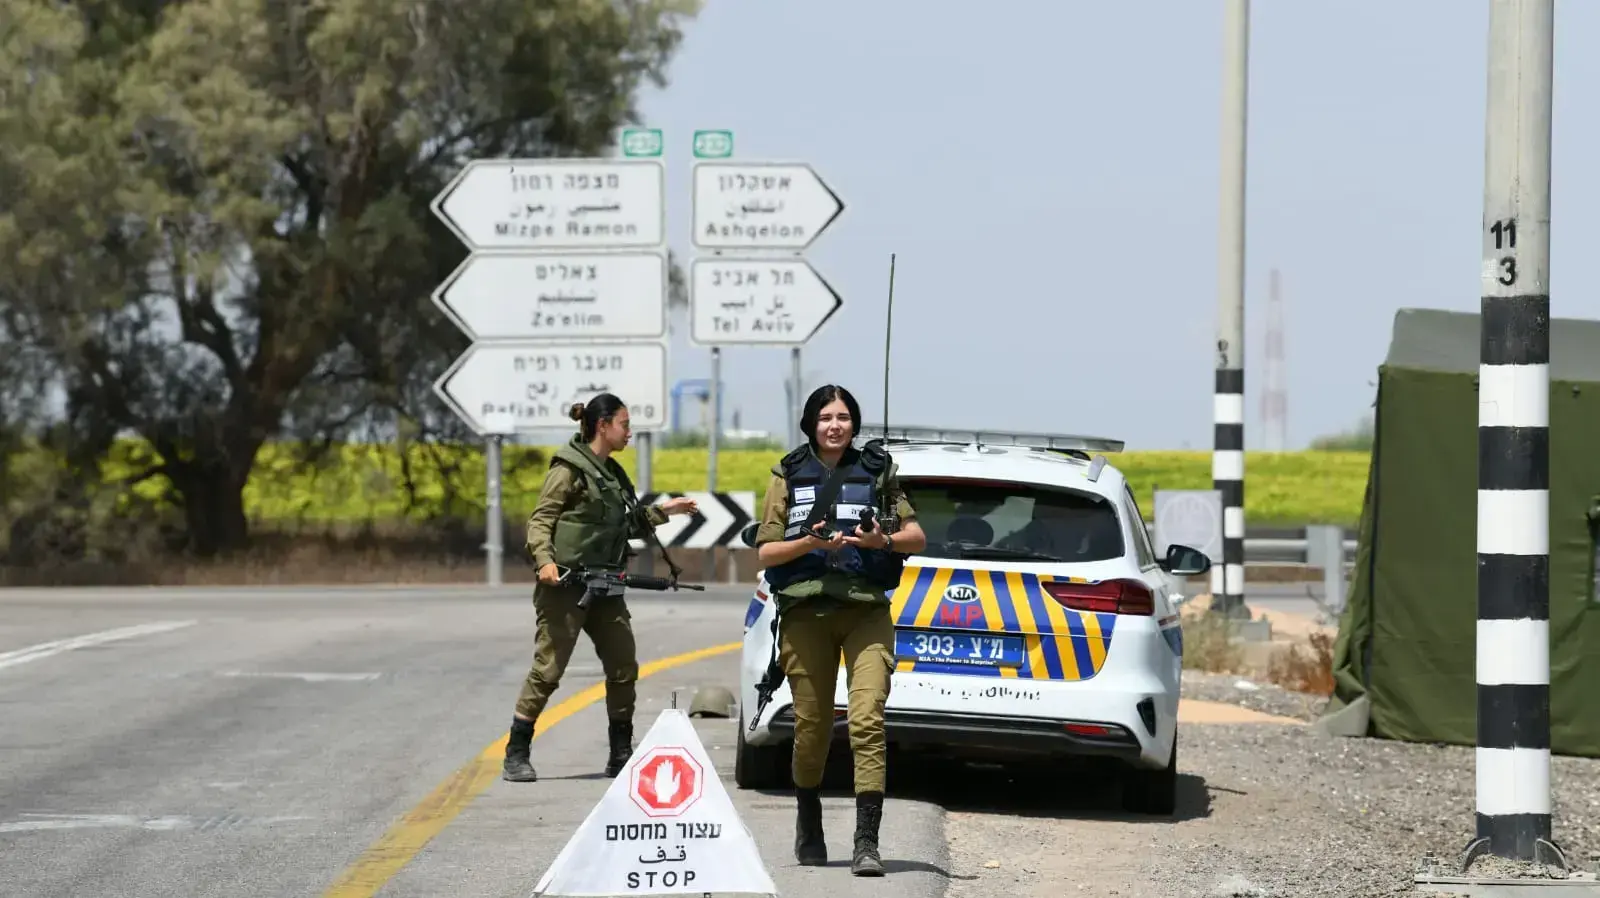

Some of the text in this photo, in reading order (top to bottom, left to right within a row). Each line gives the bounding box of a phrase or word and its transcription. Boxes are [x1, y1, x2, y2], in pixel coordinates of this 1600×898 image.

[511, 173, 619, 192] מצפה רמון
[718, 173, 792, 192] אשקלון
[494, 222, 637, 239] Mizpe Ramon
[705, 222, 804, 240] Ashqelon
[1490, 219, 1517, 250] 11
[535, 264, 597, 281] צאלים
[712, 269, 795, 287] תל אביב
[1498, 256, 1517, 287] 3
[530, 311, 605, 328] Ze'elim
[712, 316, 796, 333] Tel Aviv
[513, 355, 624, 371] מעבר רפיח
[914, 634, 955, 656] 303
[605, 822, 723, 842] עצור מחסום
[638, 844, 688, 865] قف
[626, 869, 697, 890] STOP
